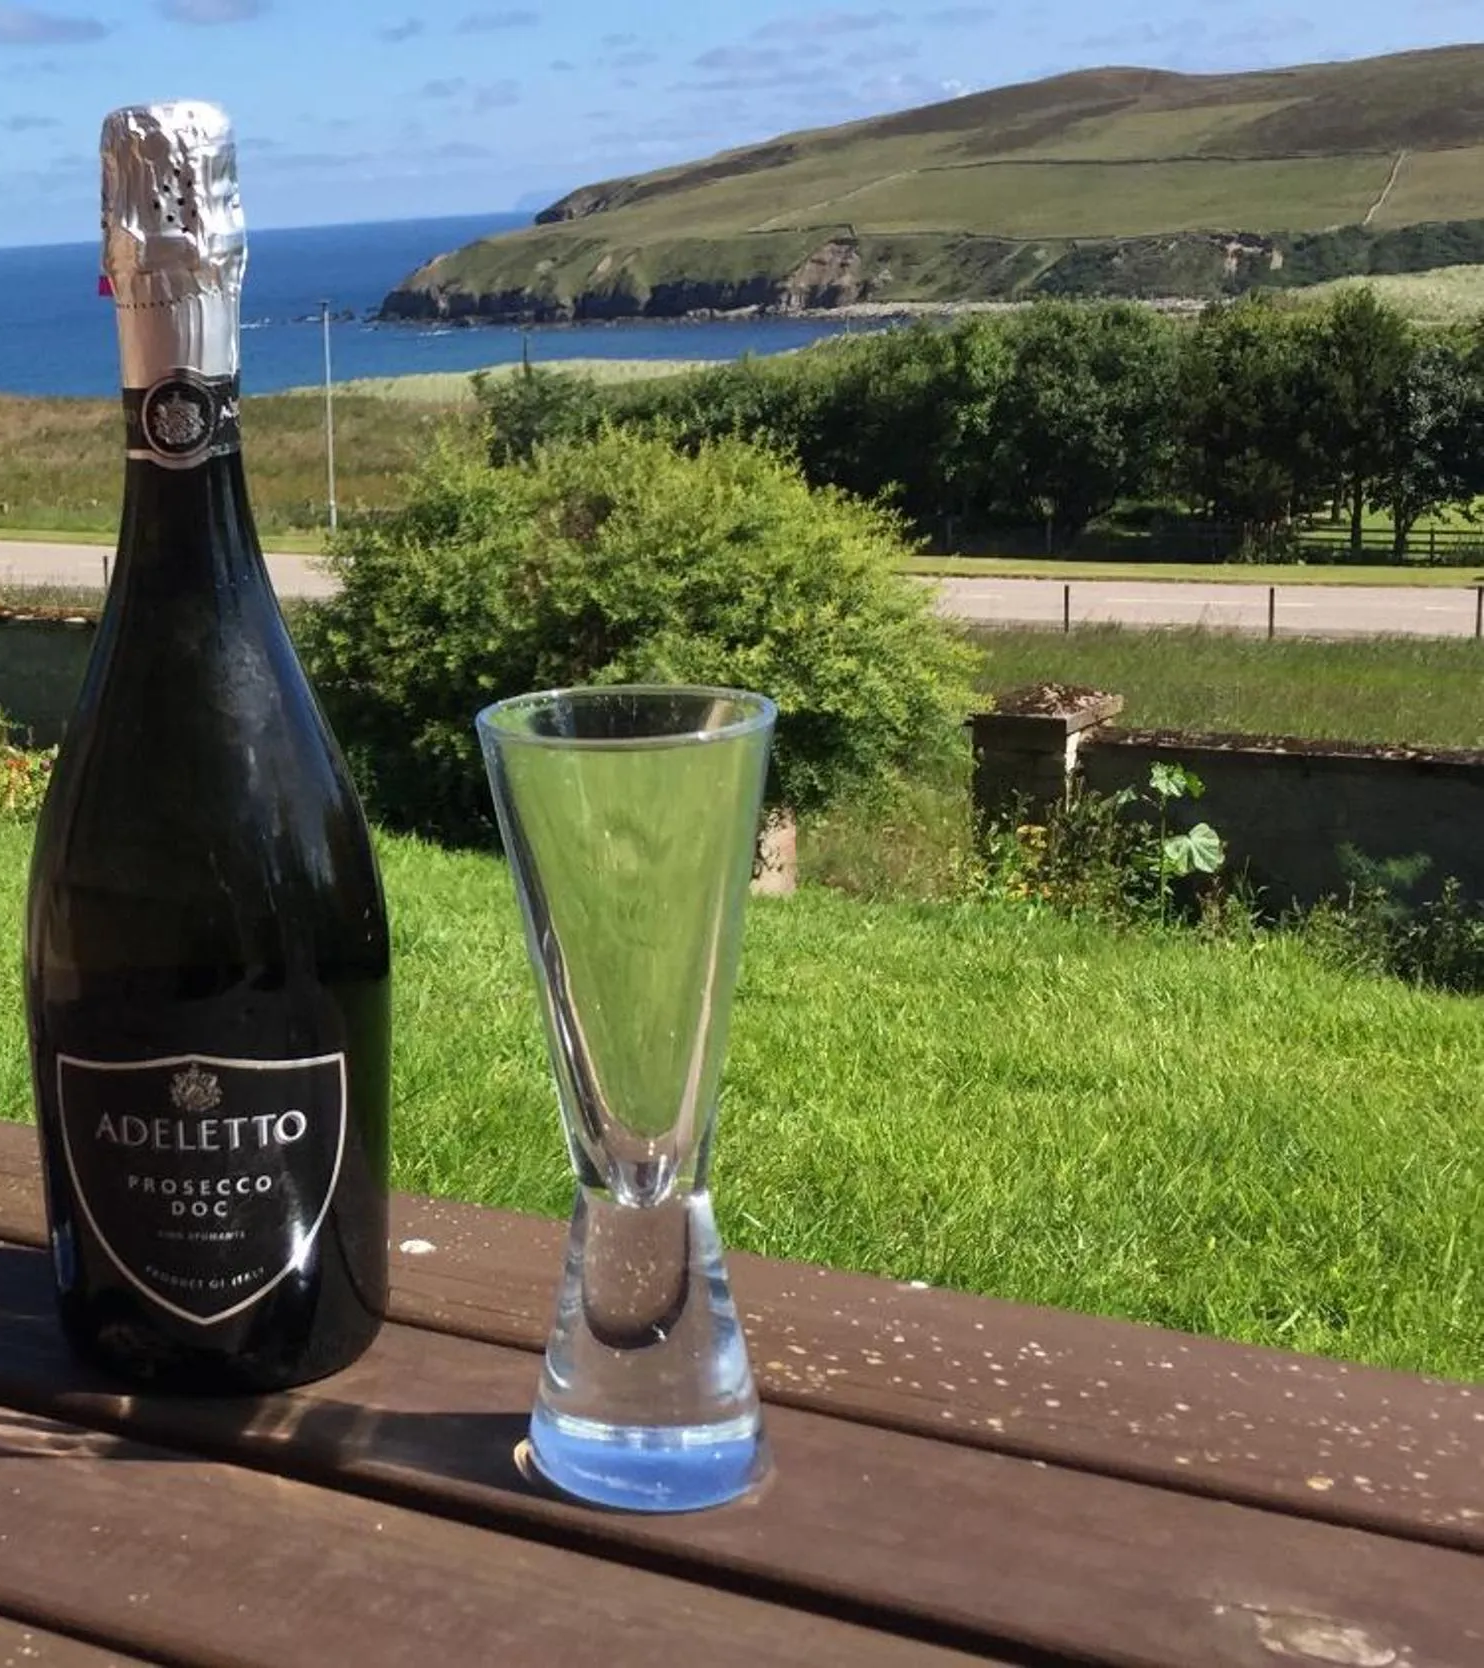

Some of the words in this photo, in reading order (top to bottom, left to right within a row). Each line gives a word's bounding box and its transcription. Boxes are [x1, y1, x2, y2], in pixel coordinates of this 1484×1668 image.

[95, 1110, 308, 1151] ADELETTO
[128, 1174, 273, 1196] PROSECCO
[171, 1200, 229, 1217] DOC
